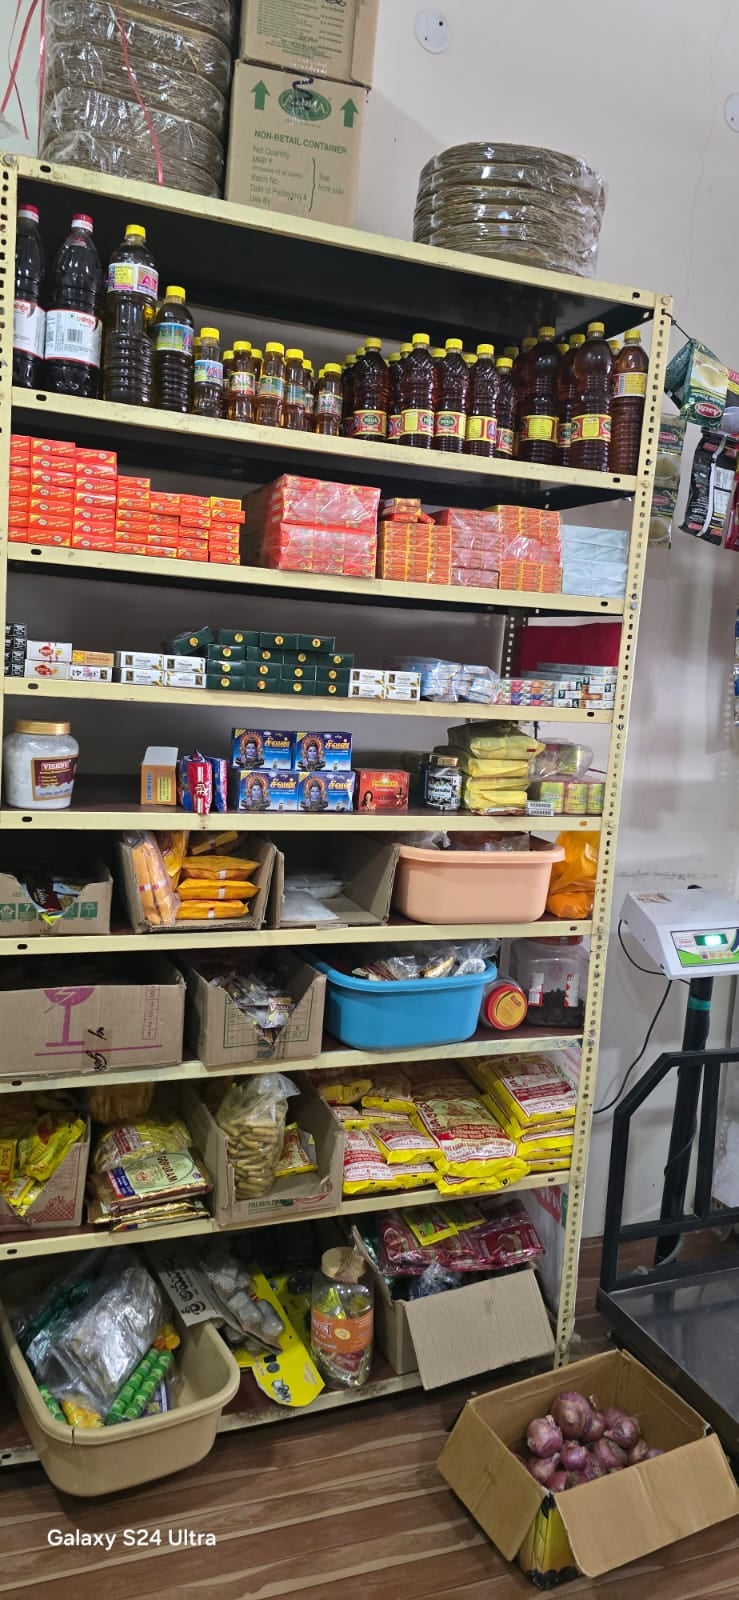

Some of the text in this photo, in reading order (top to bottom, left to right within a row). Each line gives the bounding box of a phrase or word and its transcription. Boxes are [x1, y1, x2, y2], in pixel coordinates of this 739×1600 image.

[254, 130, 348, 154] NON-RETAIL CONTAINER
[252, 145, 290, 160] Net Quantity
[252, 156, 267, 165] MRP
[250, 173, 269, 184] Batch
[319, 173, 330, 182] See
[250, 183, 264, 193] Date
[332, 187, 345, 195] side
[249, 194, 271, 207] Use By
[264, 737, 290, 748] சிவன்
[325, 739, 350, 750] சிவன்
[269, 778, 296, 789] சிவன்
[23, 903, 31, 912] 7
